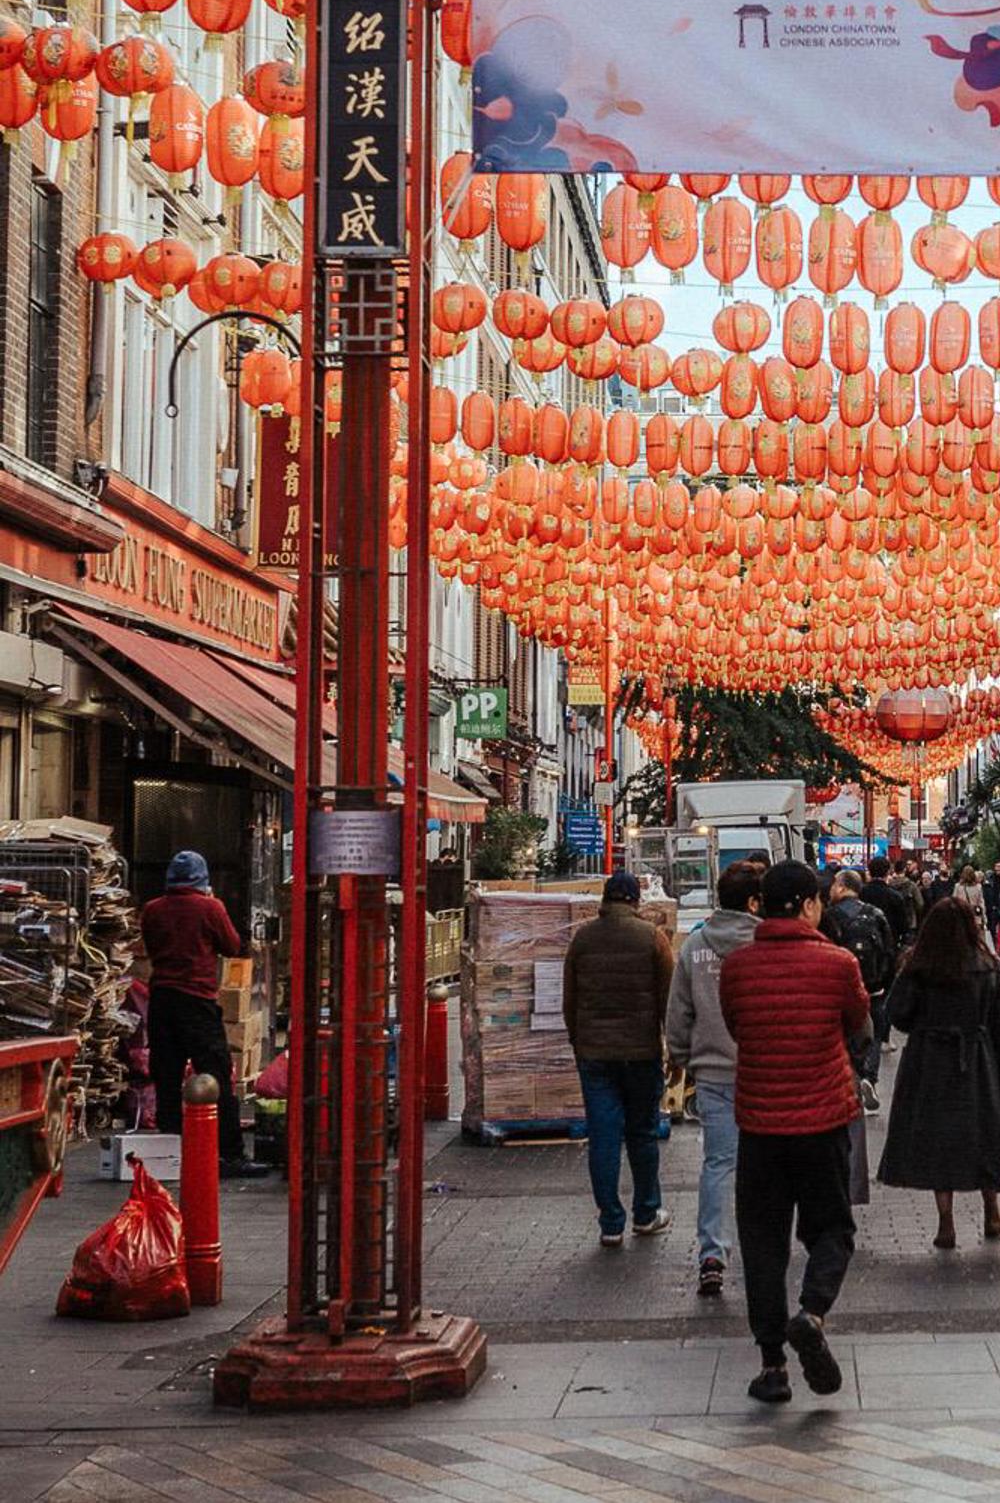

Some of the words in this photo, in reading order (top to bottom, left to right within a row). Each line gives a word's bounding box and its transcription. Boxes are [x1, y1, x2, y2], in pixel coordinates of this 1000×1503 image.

[784, 24, 829, 34] LONDON
[832, 24, 896, 34] CHINATOWN
[779, 37, 824, 48] CHINESE
[829, 37, 901, 48] ASSOCIATION
[144, 545, 188, 614] FUNG
